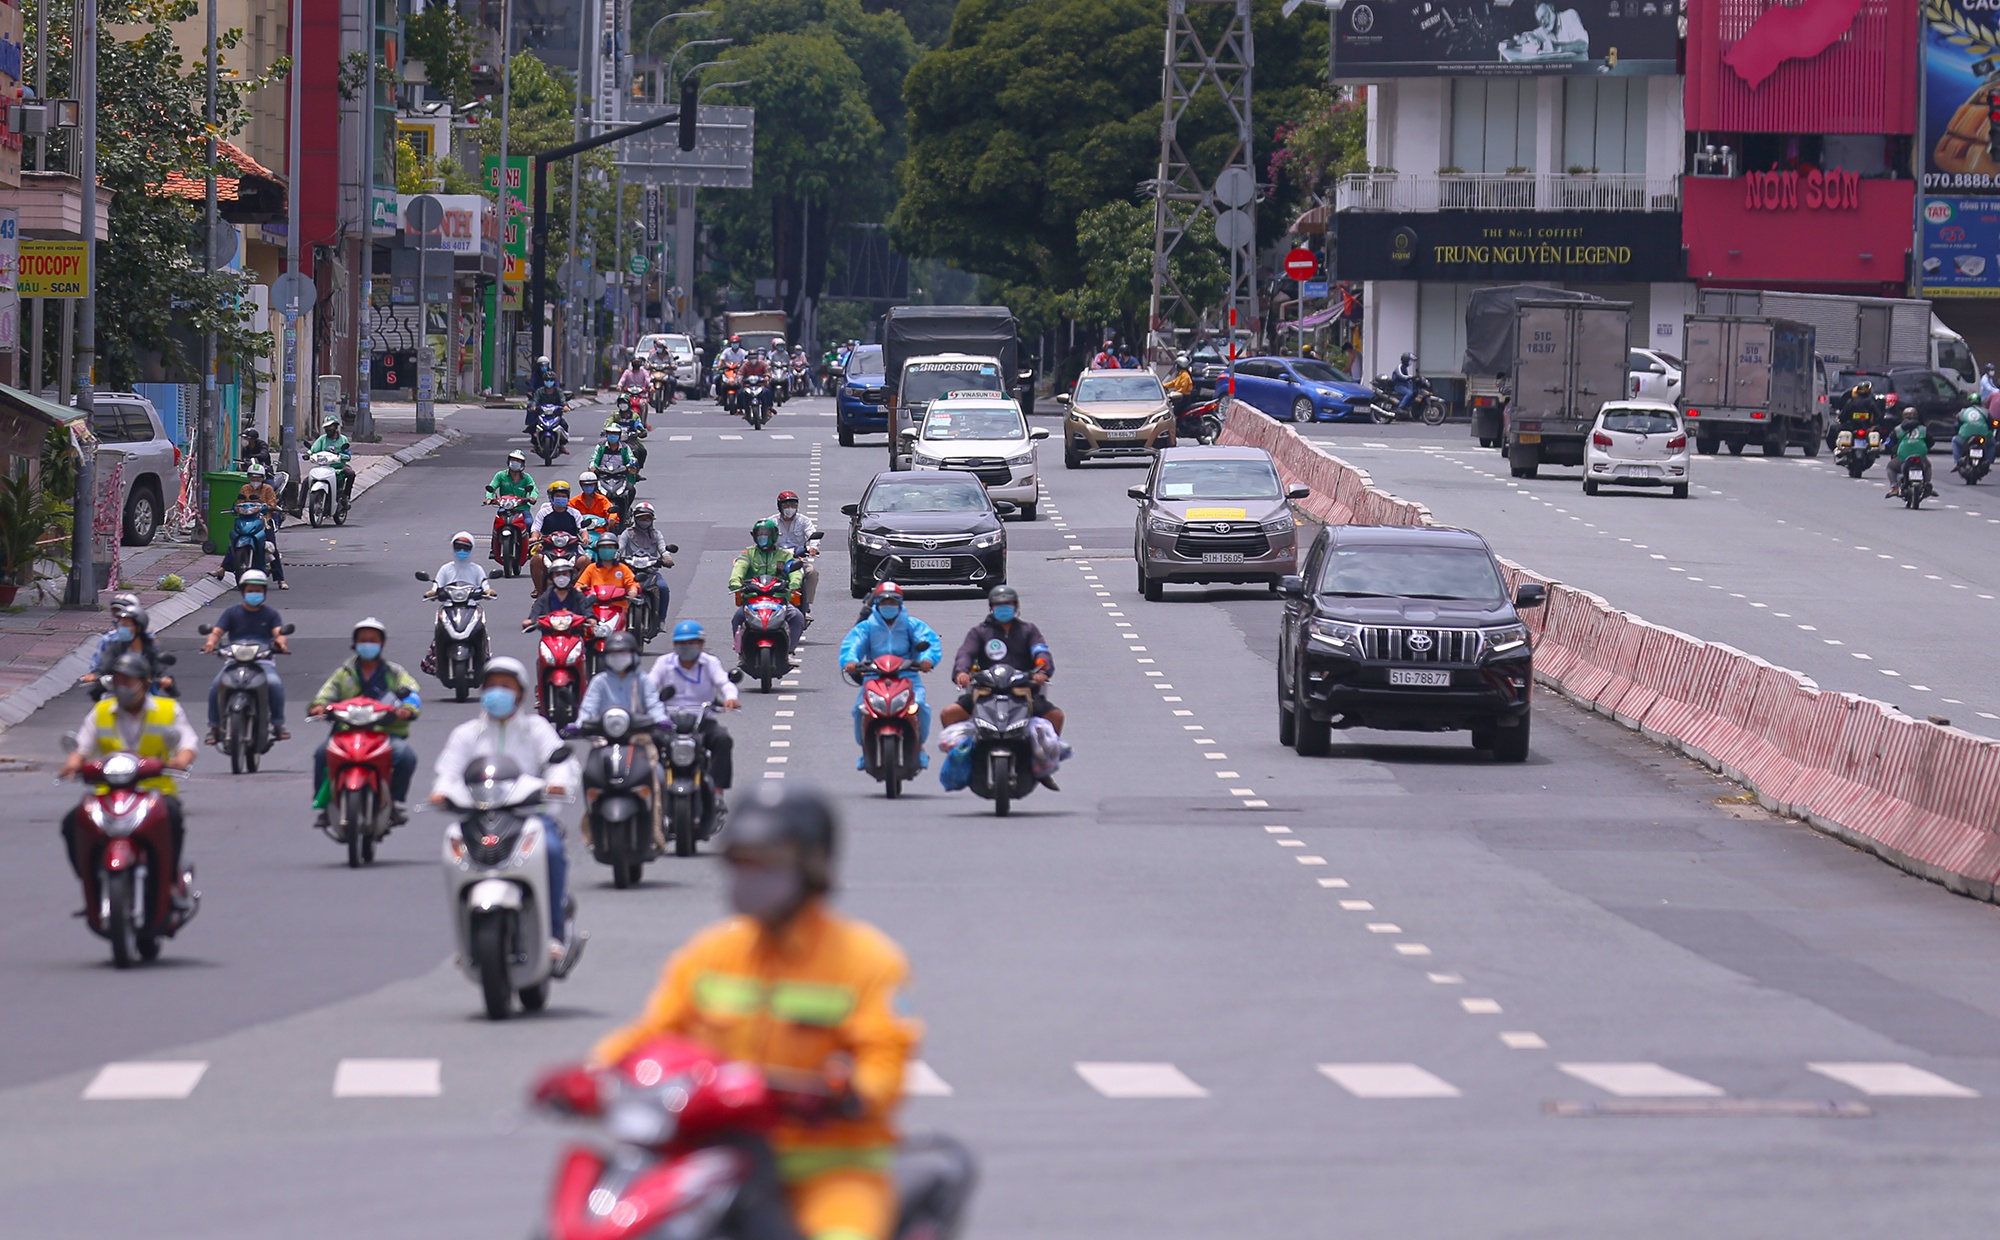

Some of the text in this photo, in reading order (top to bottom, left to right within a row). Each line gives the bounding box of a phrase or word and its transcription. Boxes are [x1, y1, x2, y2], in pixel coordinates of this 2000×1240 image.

[1745, 161, 1799, 210] NÓN
[1927, 206, 1950, 217] TATC
[1483, 228, 1583, 238] THE No.1 COFFEE!
[1434, 241, 1631, 264] TRUNG NGUYÊN LEGEND
[50, 282, 81, 293] SCAN
[1534, 331, 1552, 341] 51C
[1392, 672, 1448, 685] 51G-788.77
